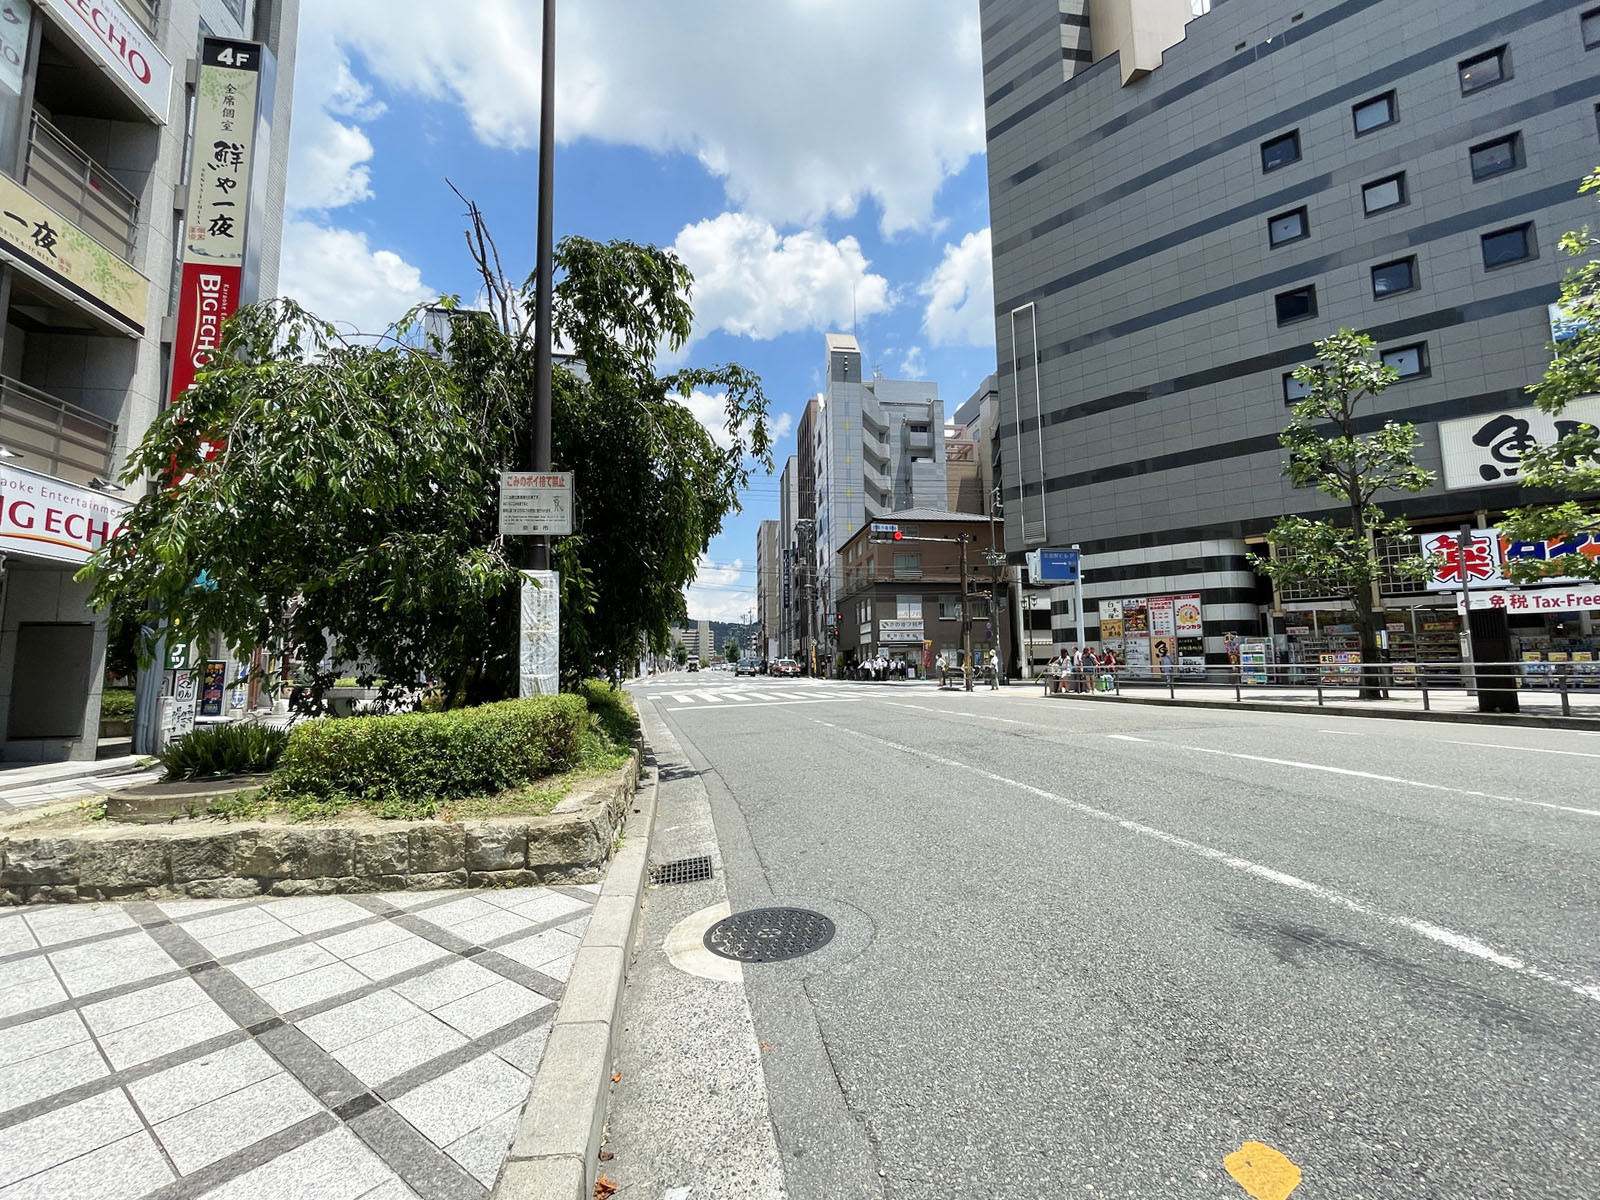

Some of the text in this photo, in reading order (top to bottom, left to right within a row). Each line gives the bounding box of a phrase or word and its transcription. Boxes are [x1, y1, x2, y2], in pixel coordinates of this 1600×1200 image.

[217, 47, 250, 67] 4F
[220, 83, 238, 132] 全席個室
[207, 140, 246, 239] 鮮や一夜
[199, 273, 222, 312] BIG
[1489, 594, 1529, 609] 免税
